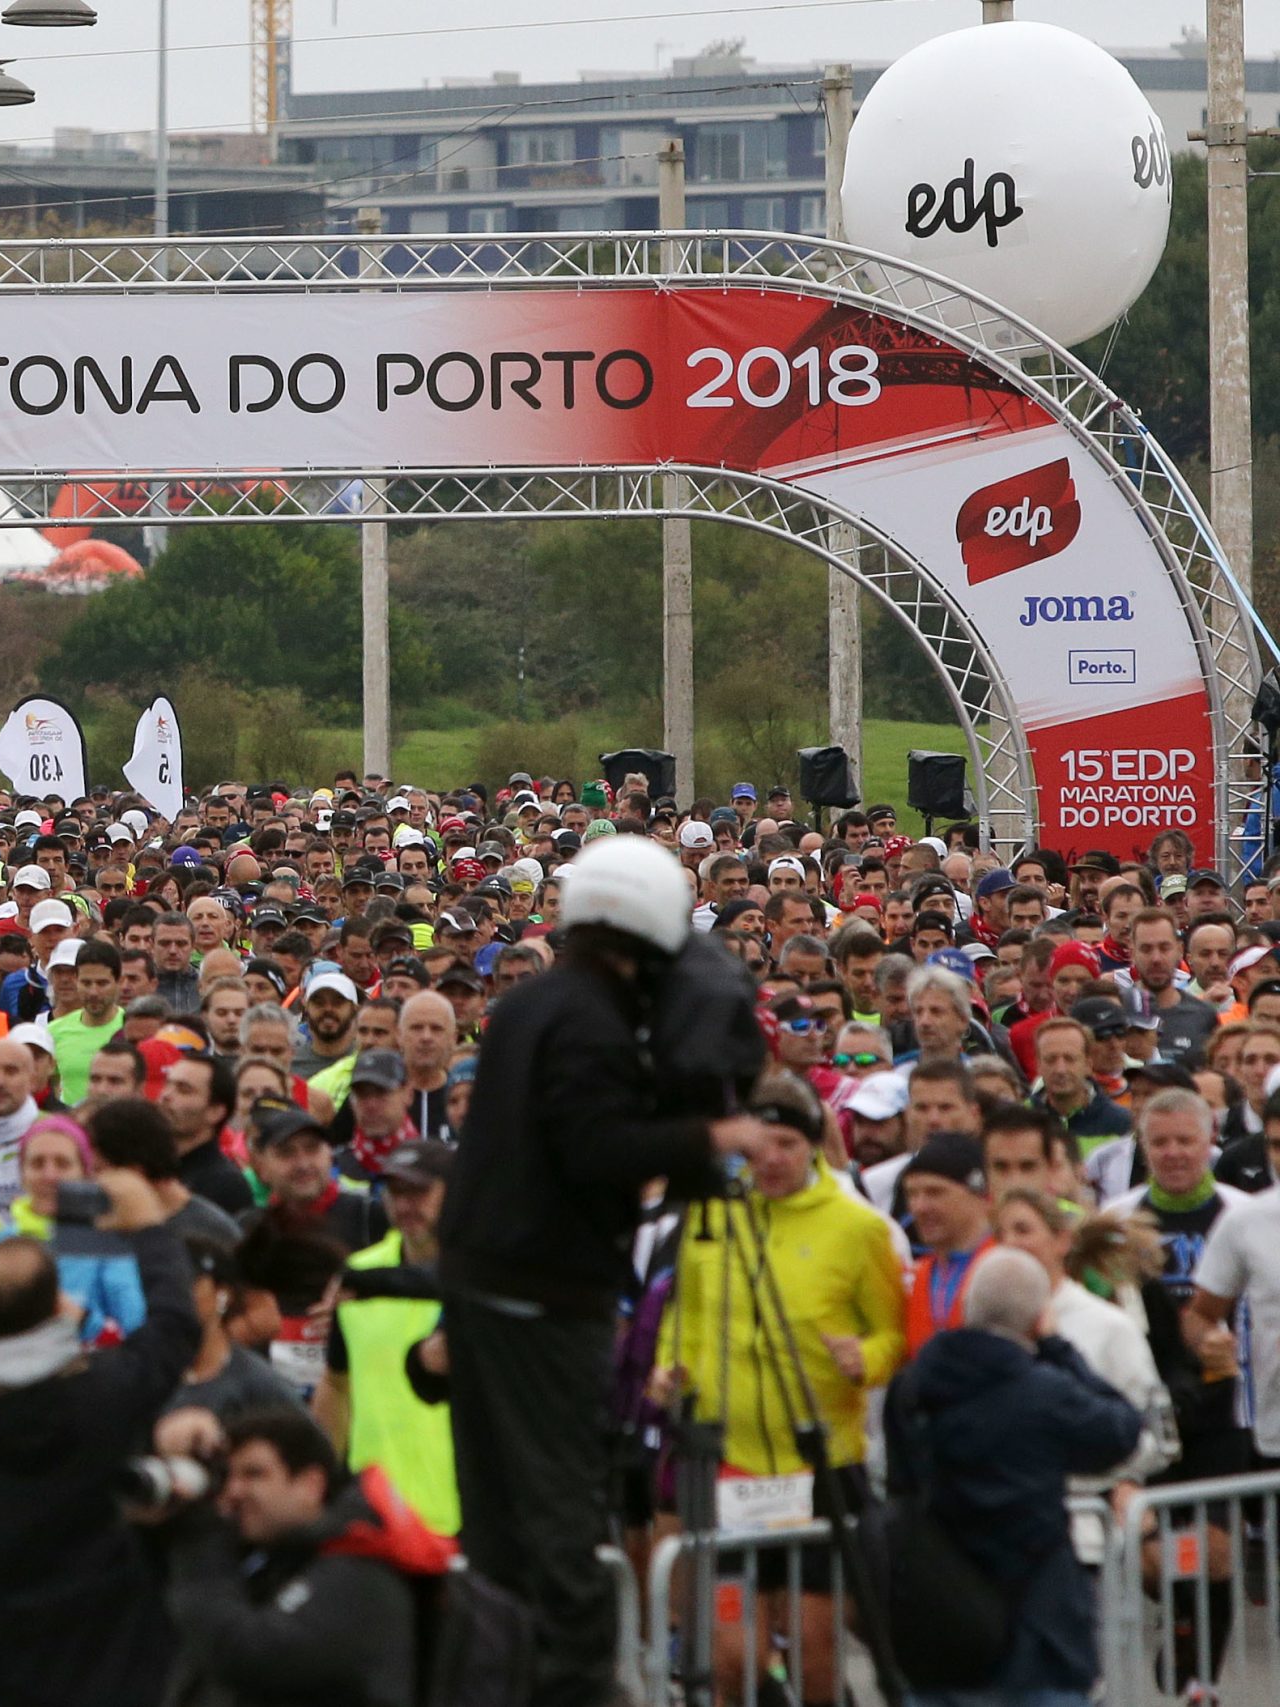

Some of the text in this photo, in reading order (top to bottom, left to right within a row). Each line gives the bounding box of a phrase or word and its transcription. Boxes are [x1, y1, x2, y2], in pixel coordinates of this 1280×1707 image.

[905, 157, 1023, 248] edp
[228, 352, 346, 414] DO
[376, 349, 654, 413] PORTO
[685, 344, 882, 409] 2018
[984, 496, 1053, 547] edp
[1078, 659, 1127, 674] Porto.
[1112, 748, 1196, 781] EDP
[1060, 785, 1196, 803] MARATONA
[1060, 804, 1197, 828] DO PORTO
